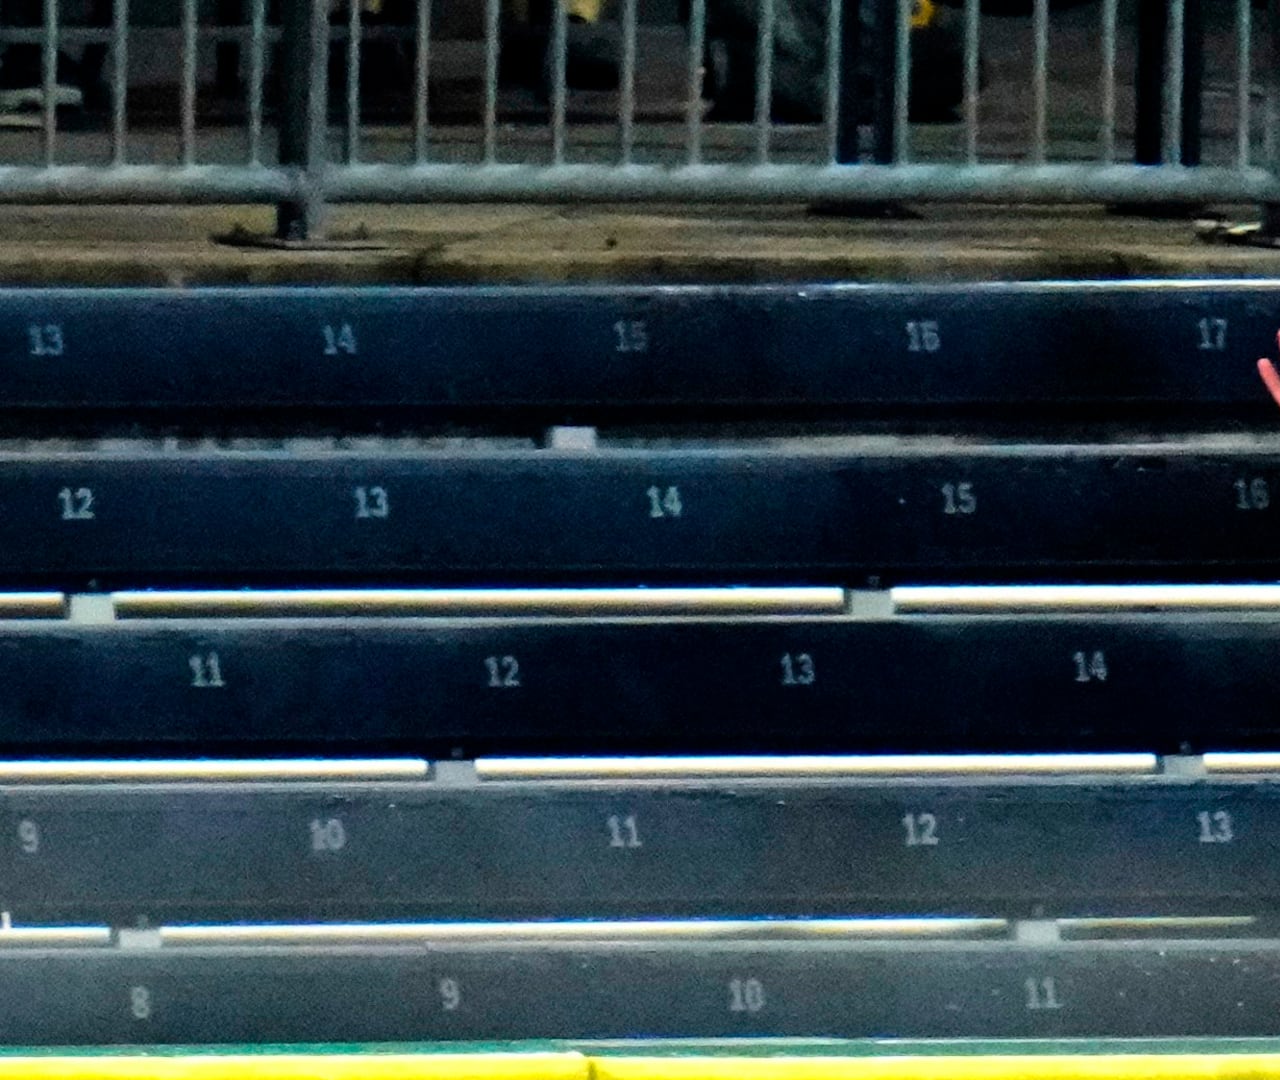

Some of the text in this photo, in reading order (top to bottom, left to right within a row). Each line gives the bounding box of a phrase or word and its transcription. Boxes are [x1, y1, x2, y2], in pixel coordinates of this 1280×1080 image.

[29, 318, 1228, 356] 13 14 15 16 17
[59, 487, 95, 519] 12
[355, 486, 389, 518] 13
[647, 486, 682, 518] 14
[941, 482, 975, 514] 15
[1234, 478, 1269, 511] 16
[189, 651, 1108, 688] 11 12 13 14
[18, 811, 1233, 853] 9 10 11 12 13
[130, 985, 151, 1019] 8
[440, 978, 461, 1011] 9
[729, 978, 766, 1012] 10
[1025, 977, 1062, 1009] 11
